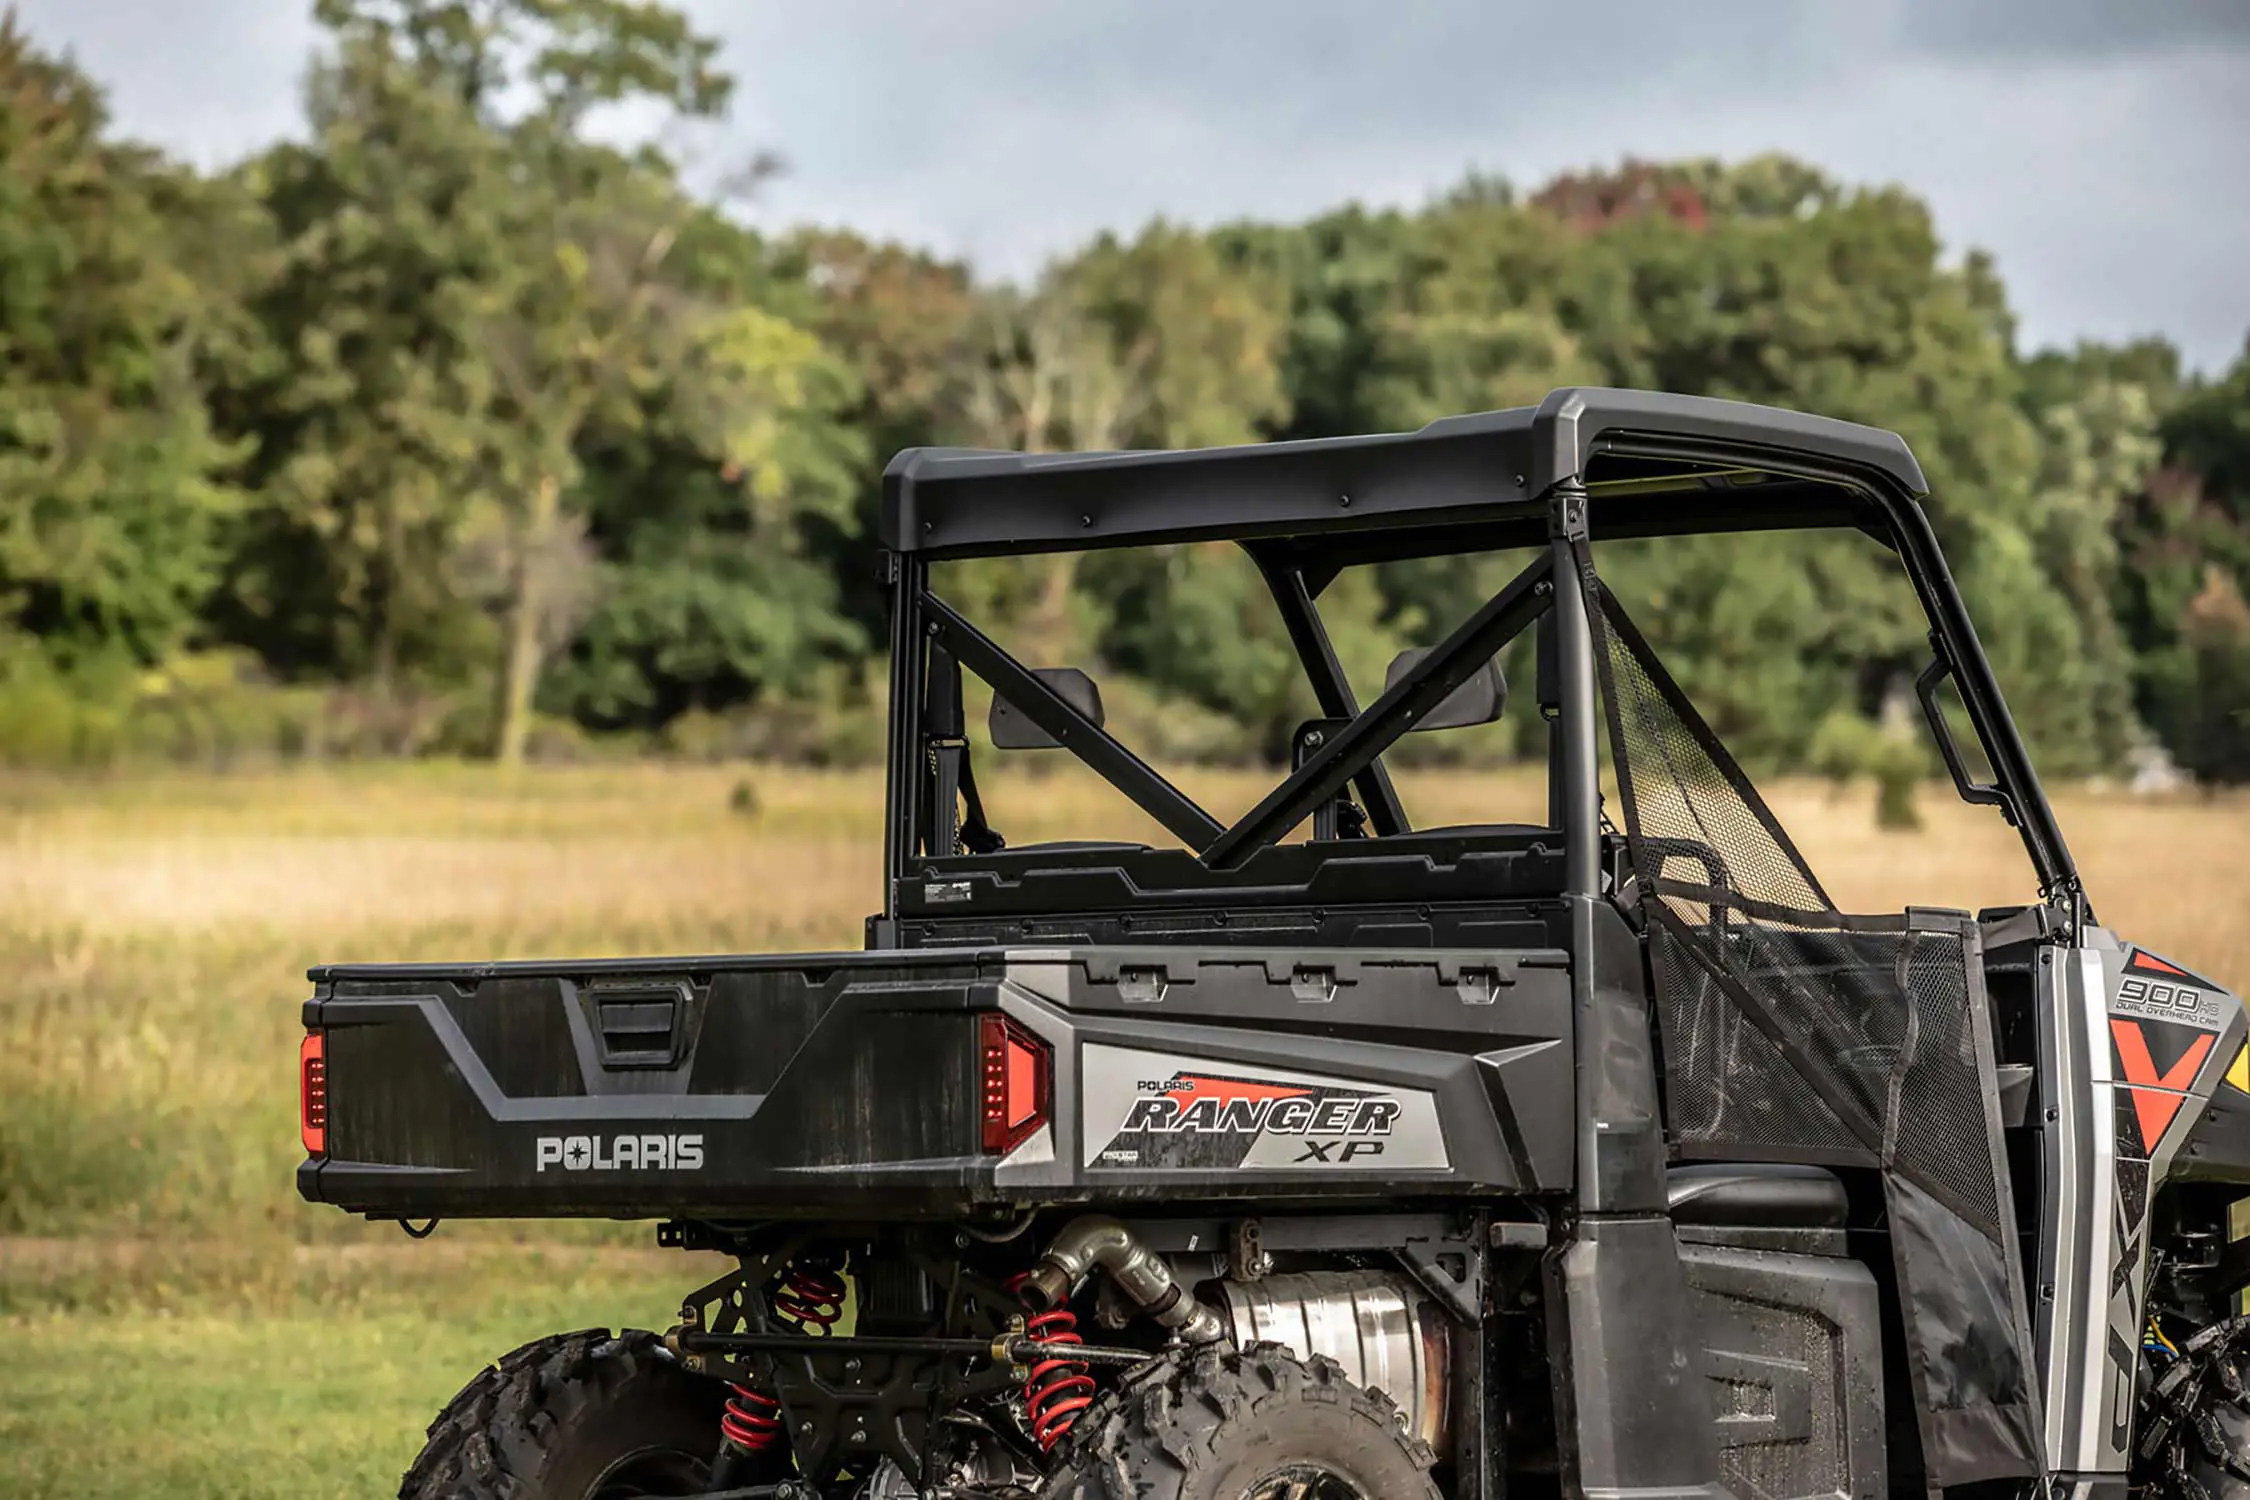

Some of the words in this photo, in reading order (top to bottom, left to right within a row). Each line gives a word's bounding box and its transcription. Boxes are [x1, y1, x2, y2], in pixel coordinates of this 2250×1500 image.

[2117, 977, 2200, 1013] 900
[2116, 1002, 2143, 1013] DUAL
[2199, 1017, 2219, 1027] CAM
[1137, 1080, 1194, 1091] POLARIS
[1120, 1097, 1402, 1137] RANGER
[536, 1134, 704, 1172] POLARIS
[1292, 1140, 1387, 1163] XP
[2108, 1198, 2142, 1455] XP
